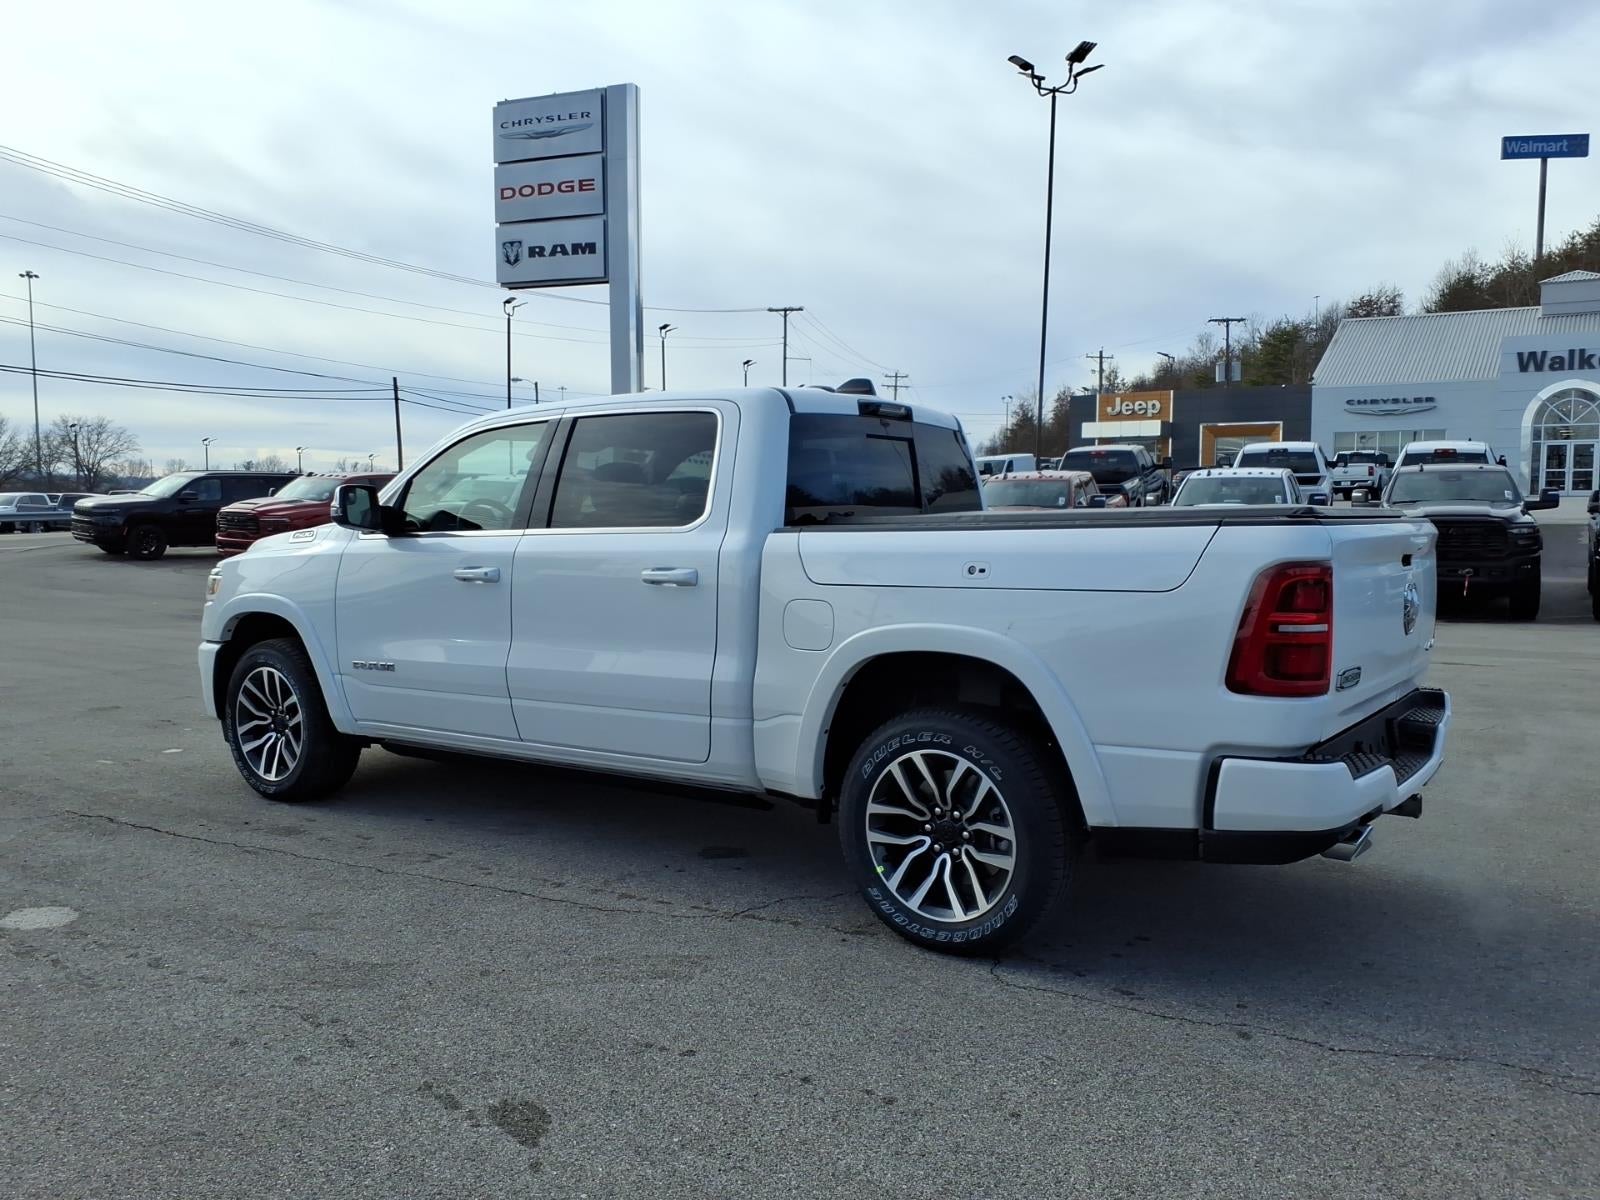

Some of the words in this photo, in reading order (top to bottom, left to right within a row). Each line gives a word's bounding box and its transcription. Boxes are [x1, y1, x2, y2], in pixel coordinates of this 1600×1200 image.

[500, 111, 591, 129] CHRYSLER
[1505, 139, 1569, 153] Walmart
[500, 178, 596, 201] DODGE
[528, 242, 597, 259] RAM
[1516, 348, 1600, 373] Walk
[1106, 396, 1162, 417] Jeep
[1345, 396, 1436, 407] CHRYSLER
[862, 731, 953, 779] DUELER
[867, 887, 1019, 943] BRIDGESTONE
